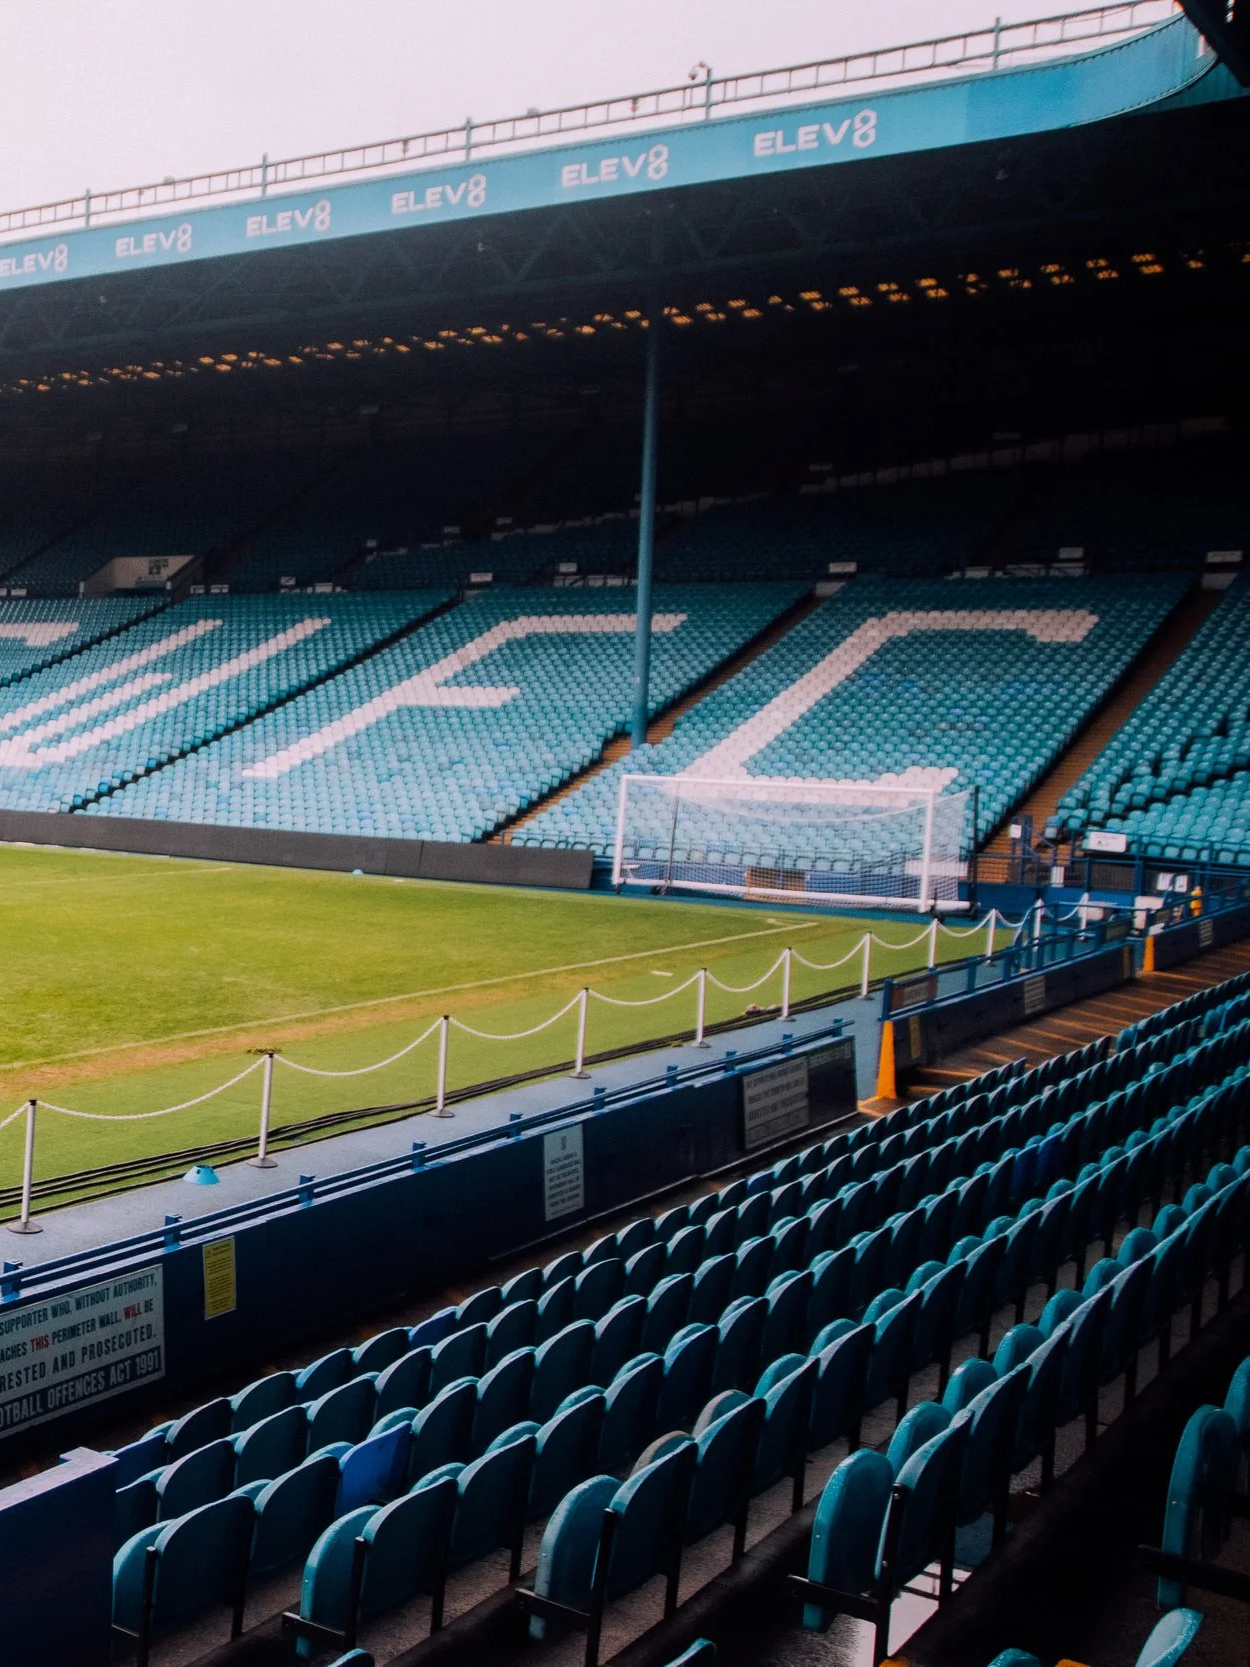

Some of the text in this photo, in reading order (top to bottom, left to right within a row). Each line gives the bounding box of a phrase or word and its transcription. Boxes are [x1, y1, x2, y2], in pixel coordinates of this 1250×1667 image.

[753, 108, 877, 159] ELEV8
[560, 143, 668, 189] ELEV8
[391, 173, 486, 216] ELEV8
[115, 222, 192, 258] ELEV8
[245, 199, 330, 239] ELEV8
[0, 1307, 48, 1336] SUPPORTER
[75, 1288, 110, 1311] WITHOUT
[30, 1335, 50, 1352] THIS
[52, 1318, 96, 1345] PERIMETER
[123, 1303, 142, 1320] WILL
[144, 1299, 153, 1313] BE
[53, 1352, 75, 1374] AND
[82, 1323, 157, 1363] PROSECUTED.
[48, 1373, 105, 1408] OFFENCES
[110, 1359, 132, 1386] ACT
[136, 1350, 159, 1376] 1991
